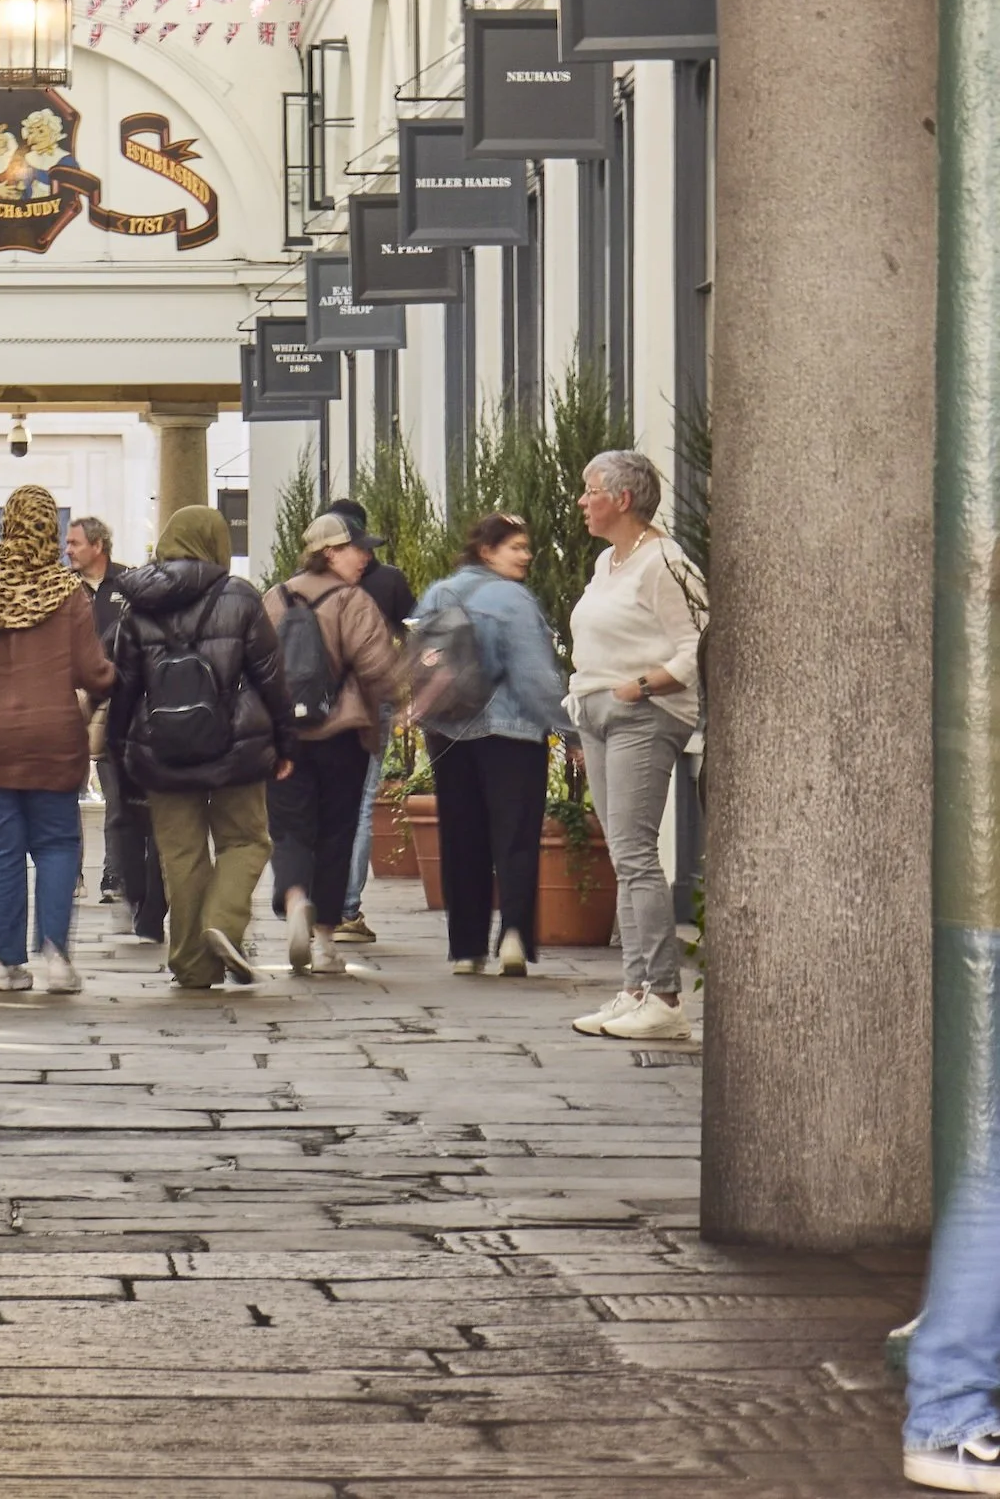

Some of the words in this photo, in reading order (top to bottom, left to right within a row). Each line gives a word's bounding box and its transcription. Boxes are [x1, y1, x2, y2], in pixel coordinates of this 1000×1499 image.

[506, 71, 572, 82] NEUHAUS
[125, 141, 211, 204] ESTABLISHED
[415, 178, 463, 188] MILLER
[464, 177, 512, 188] HARRIS
[127, 217, 165, 234] 1787
[339, 304, 374, 315] SHOP
[275, 354, 323, 363] CHELSEA
